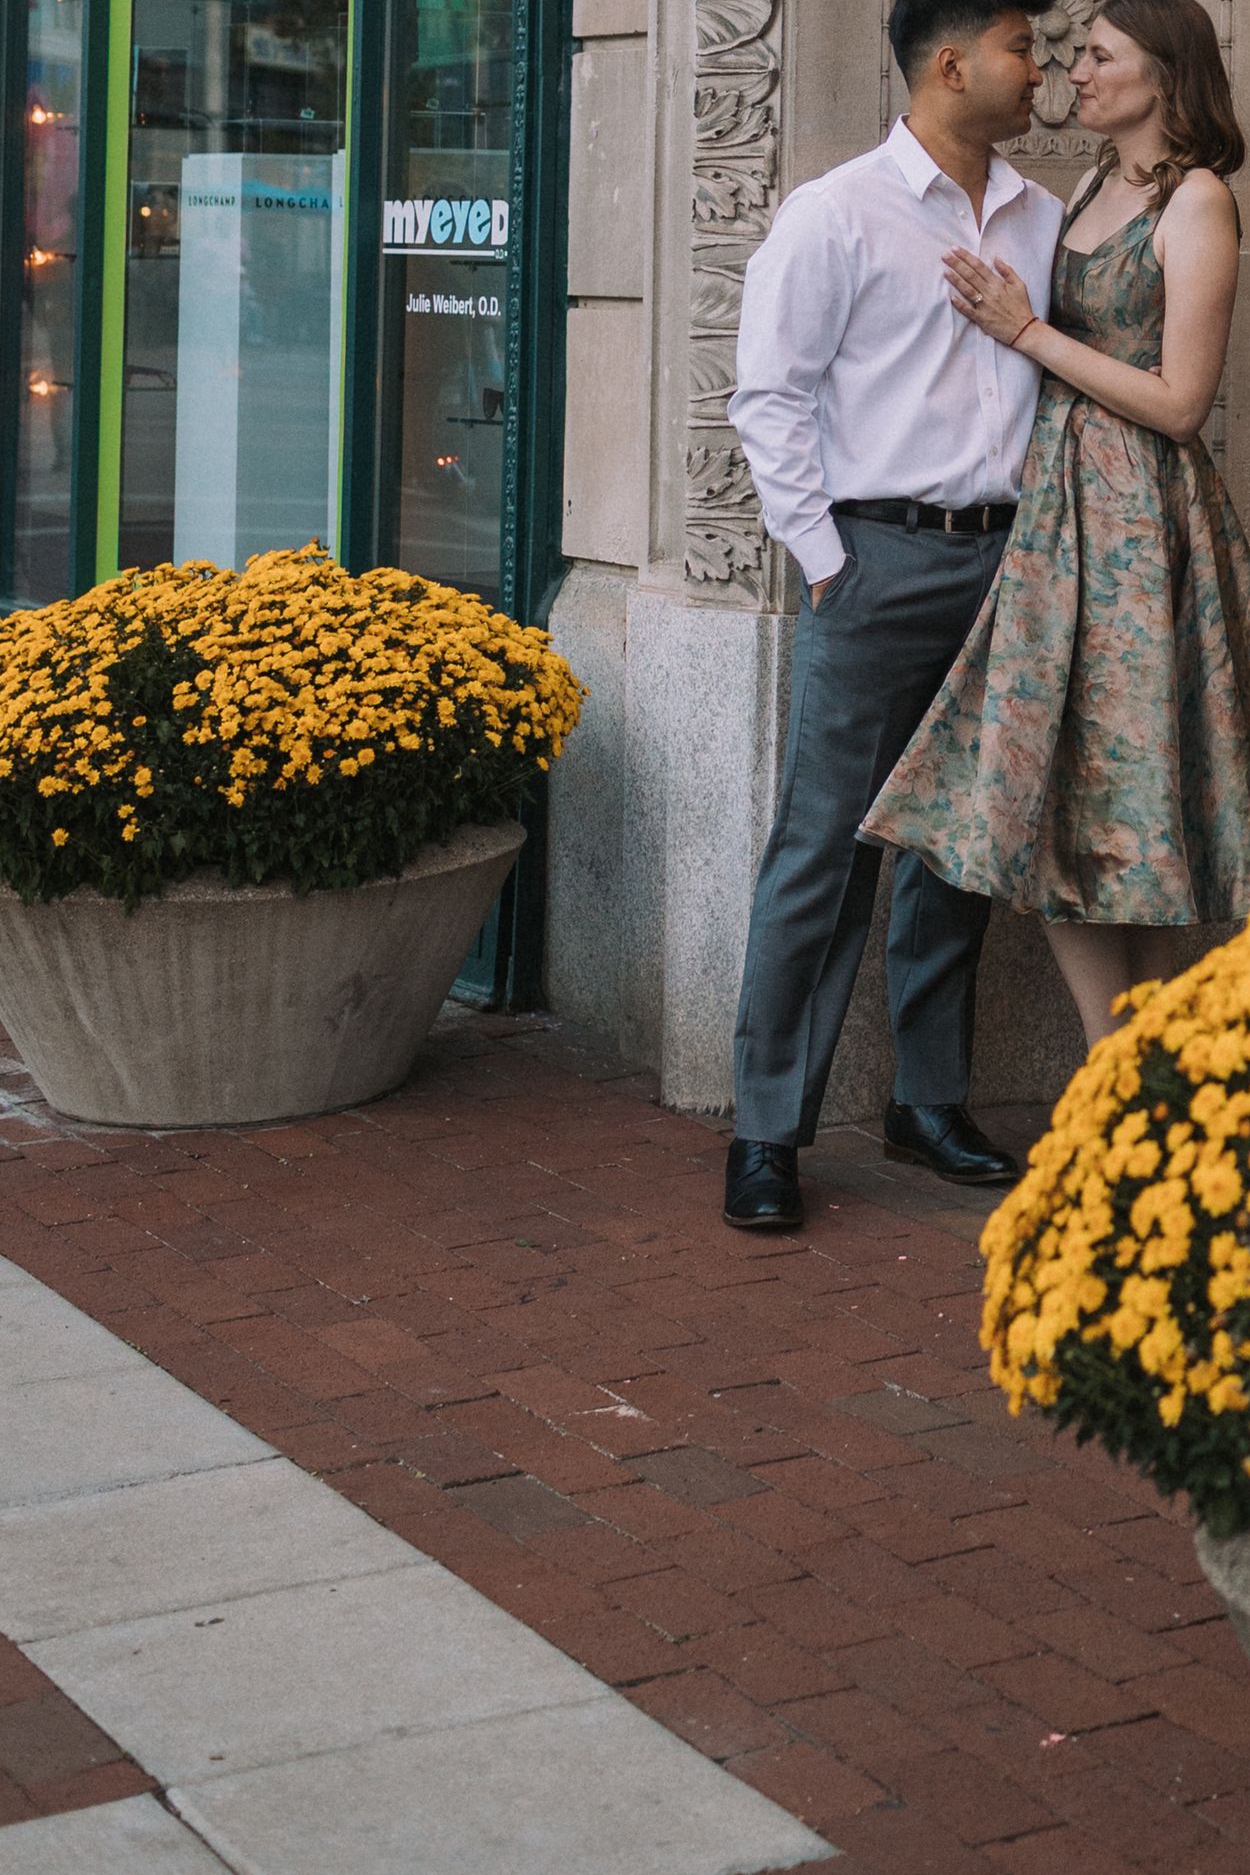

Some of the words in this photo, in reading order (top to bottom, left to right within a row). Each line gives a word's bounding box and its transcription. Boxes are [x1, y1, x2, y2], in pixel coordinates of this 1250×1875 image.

[188, 195, 236, 207] LONGCHAMP
[406, 293, 431, 313] Julie
[432, 294, 476, 319] Weibert,
[478, 296, 501, 317] O.D.
